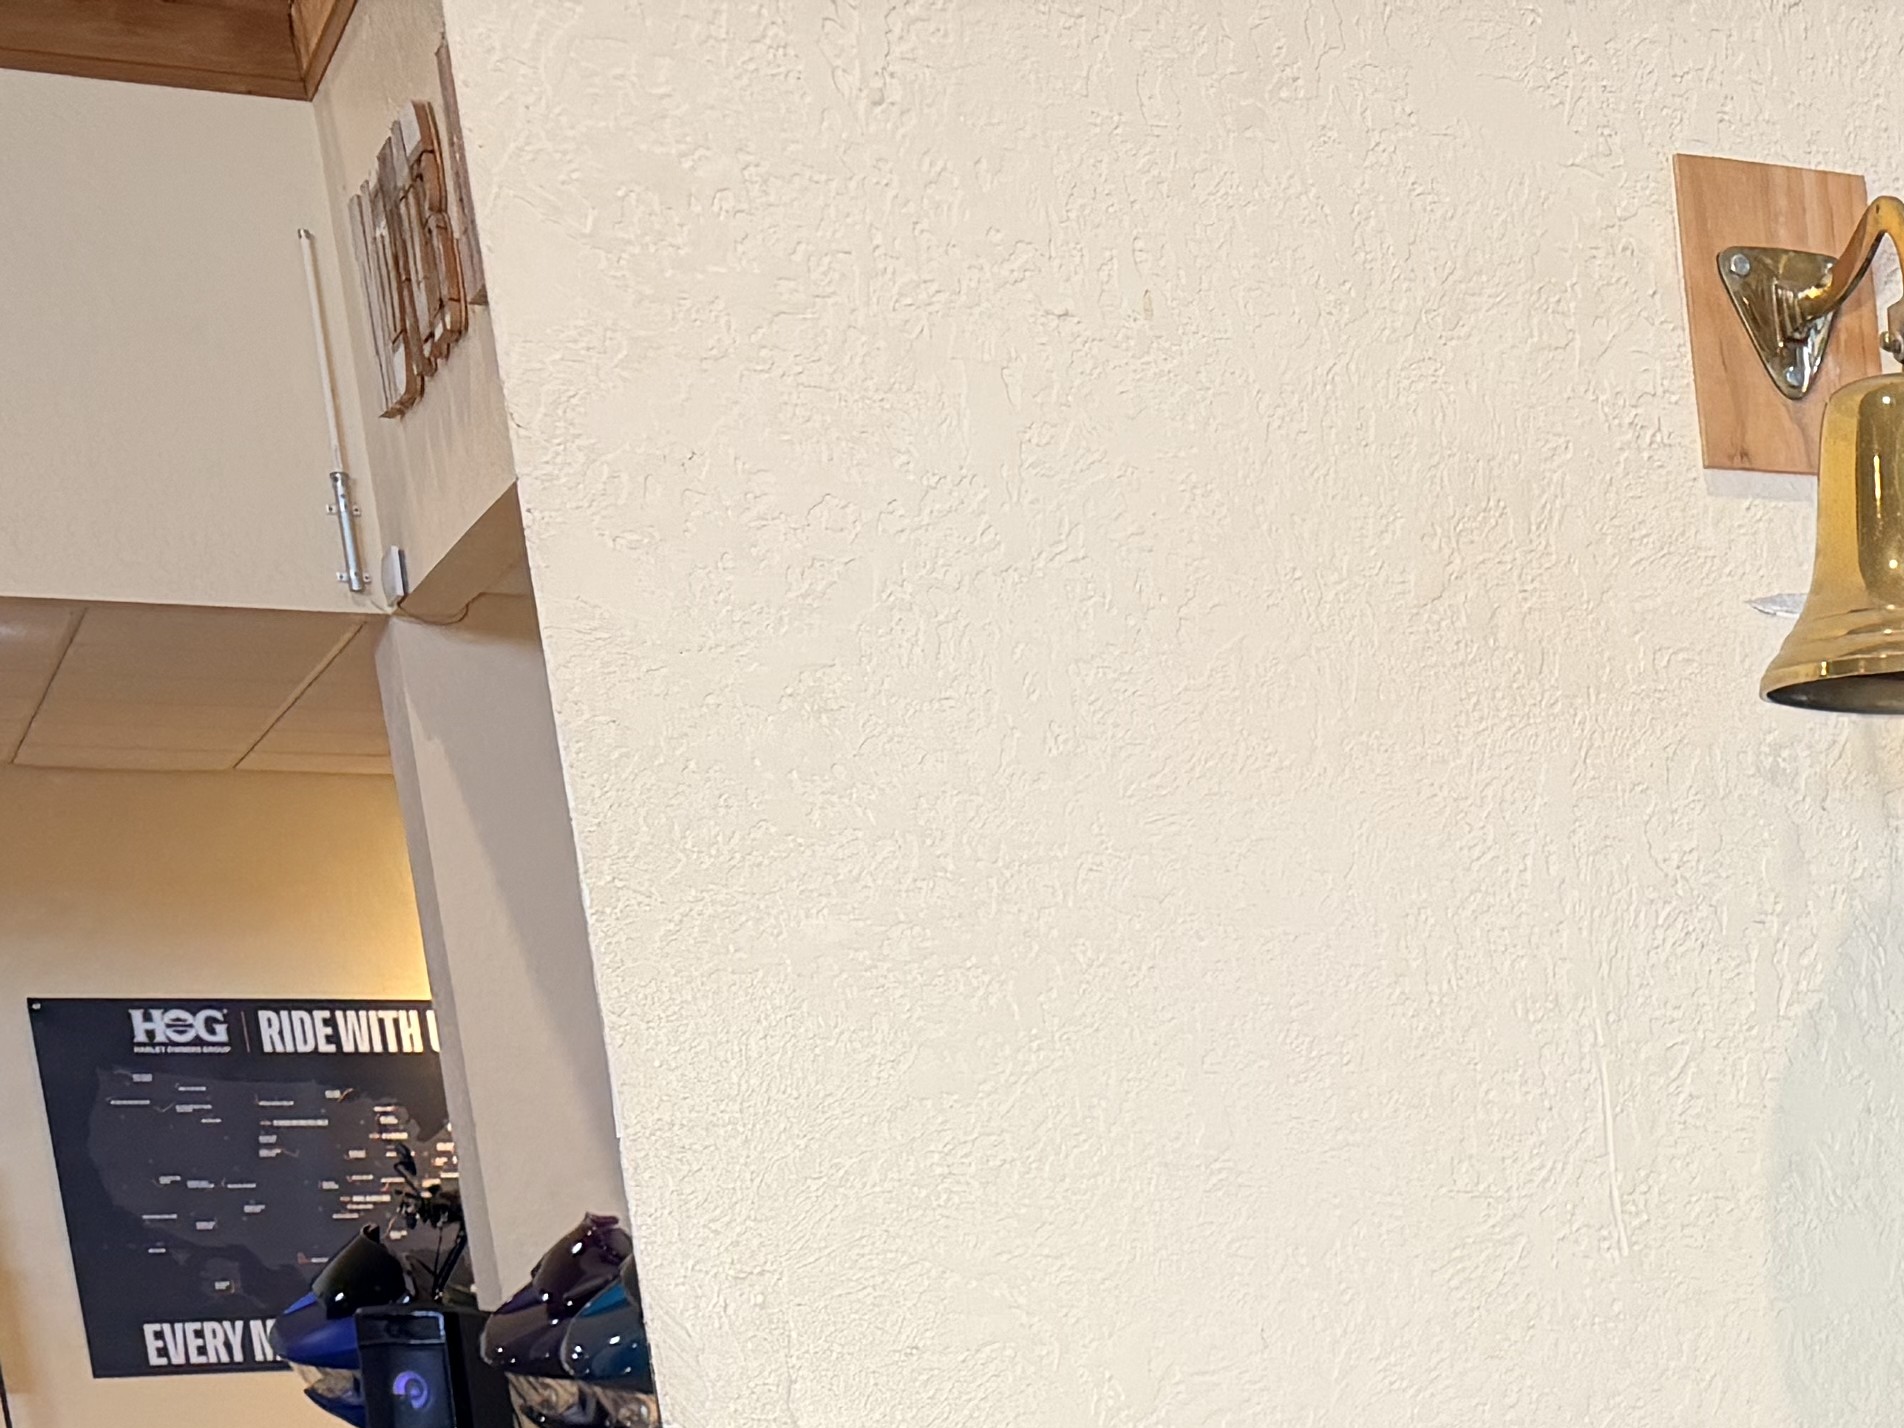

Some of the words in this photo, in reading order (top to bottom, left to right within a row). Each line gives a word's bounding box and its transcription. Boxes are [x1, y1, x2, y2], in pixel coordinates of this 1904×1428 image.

[257, 1009, 336, 1054] RIDE
[335, 1009, 424, 1054] WITH
[143, 1319, 245, 1367] EVERY
